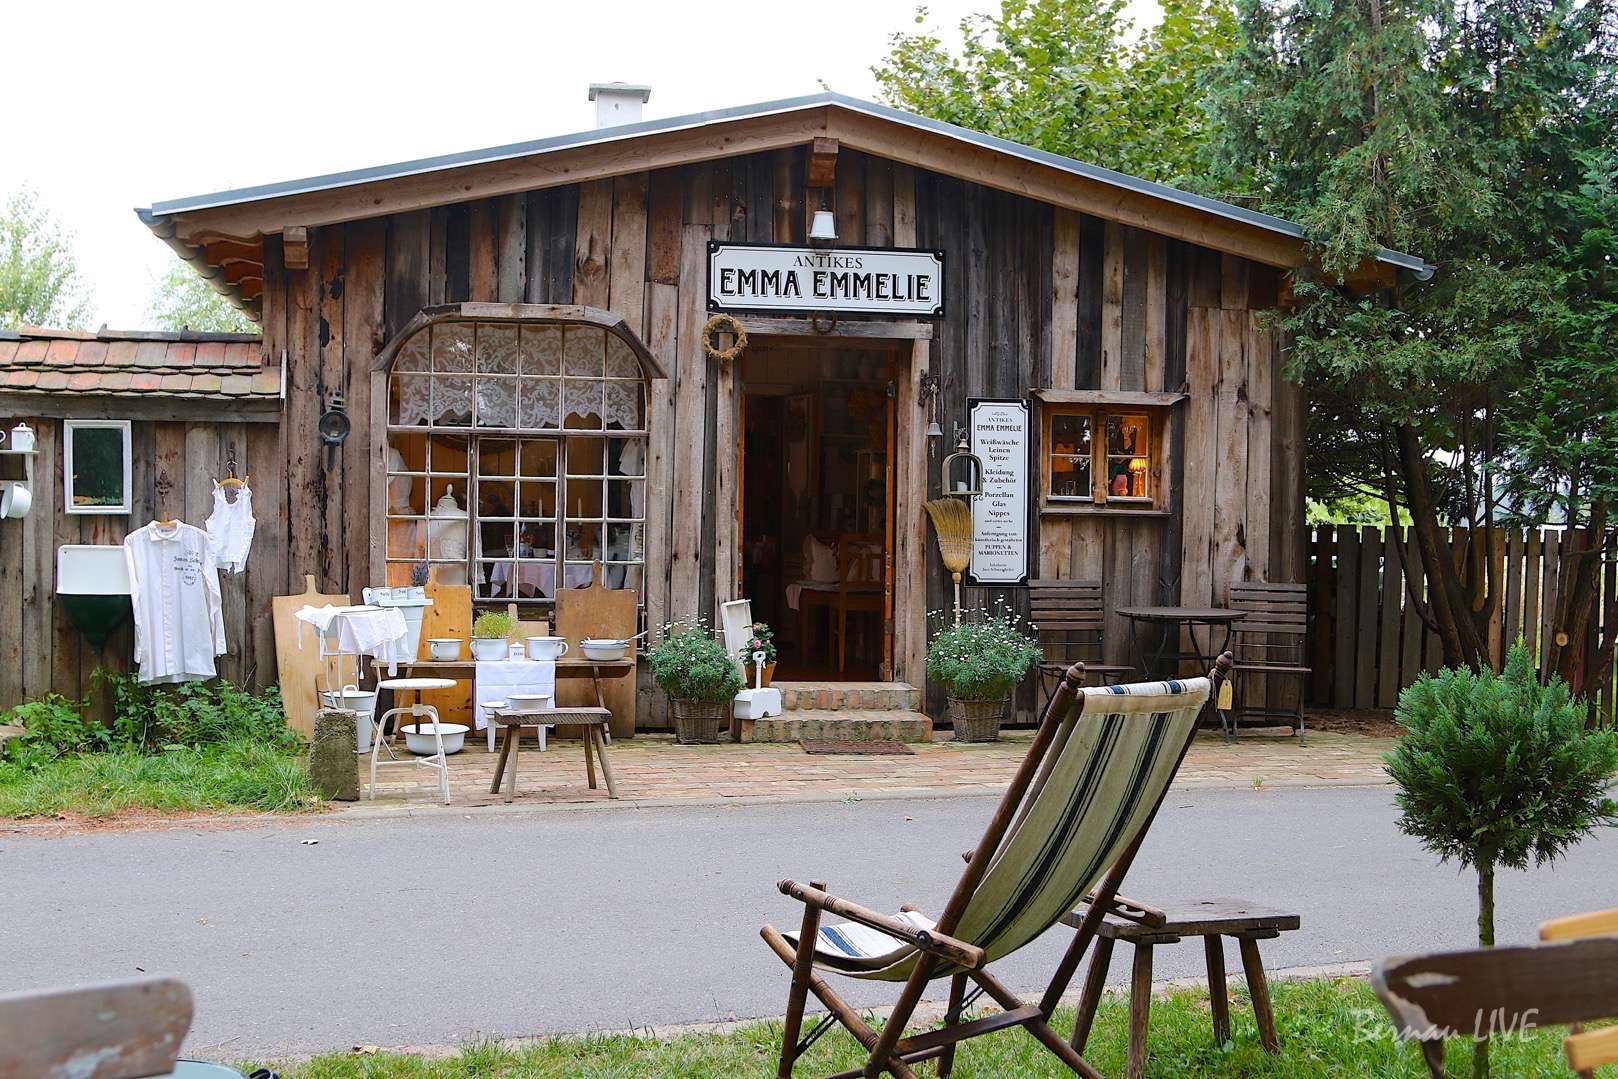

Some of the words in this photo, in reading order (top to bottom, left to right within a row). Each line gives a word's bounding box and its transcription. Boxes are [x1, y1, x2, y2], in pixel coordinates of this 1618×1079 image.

[793, 256, 863, 269] ANTIKES
[720, 268, 803, 298] EMMA
[813, 271, 932, 302] EMMELIE
[985, 469, 1015, 477] Kleidung
[988, 510, 1010, 518] Nippes
